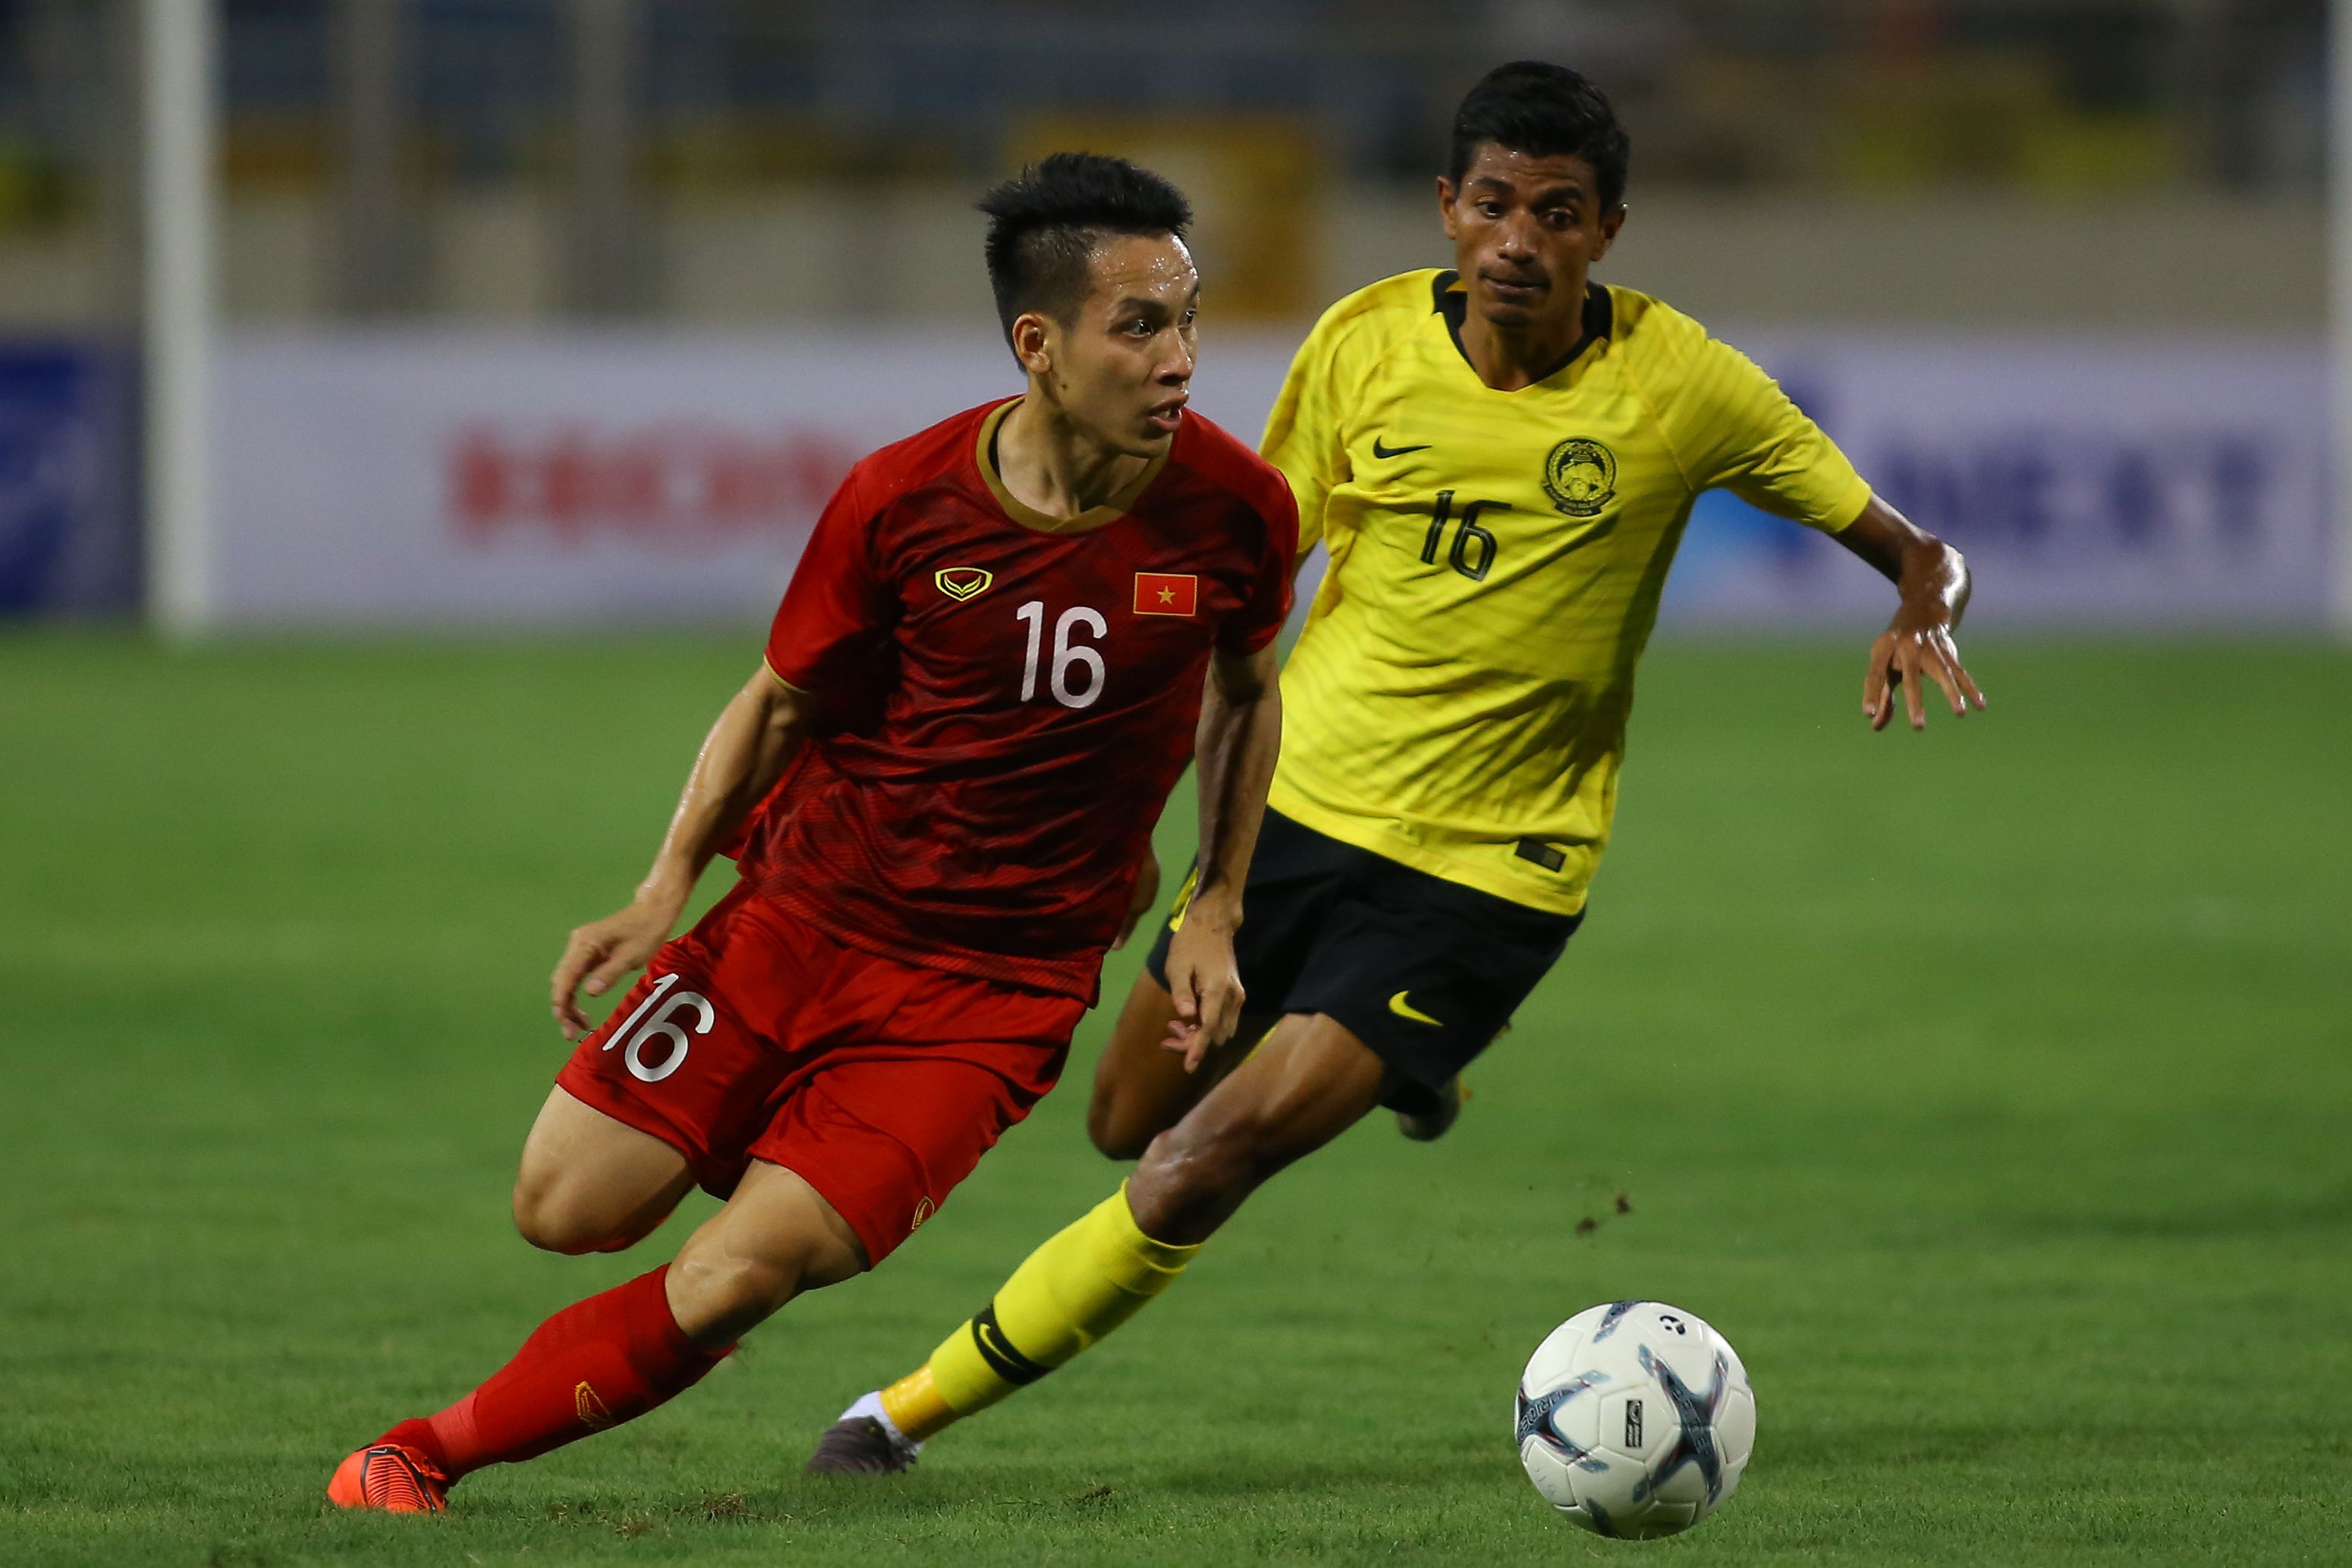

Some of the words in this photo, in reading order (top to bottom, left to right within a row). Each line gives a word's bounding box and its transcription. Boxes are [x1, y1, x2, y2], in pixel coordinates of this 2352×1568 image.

[1420, 489, 1513, 583] 16
[1016, 600, 1108, 709] 16
[602, 972, 715, 1083] 16
